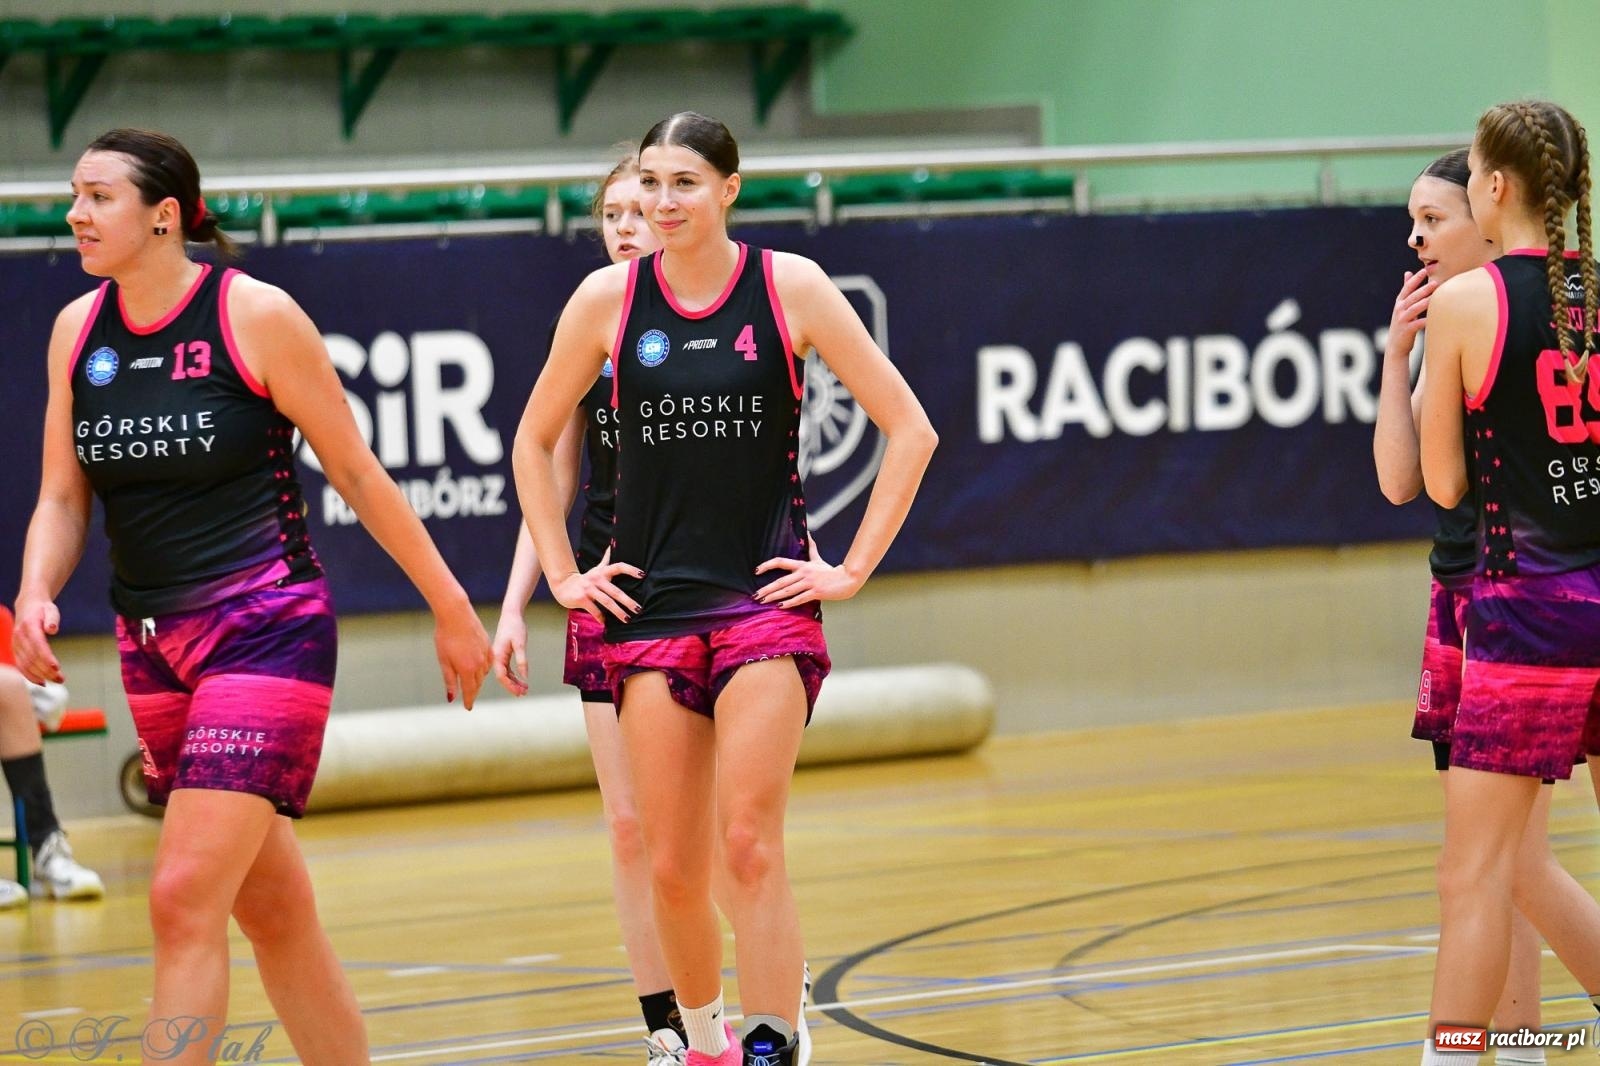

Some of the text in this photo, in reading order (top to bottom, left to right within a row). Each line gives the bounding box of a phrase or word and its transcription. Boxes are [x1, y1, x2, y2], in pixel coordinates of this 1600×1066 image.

[687, 338, 718, 351] PROTON
[734, 324, 758, 361] 4
[171, 340, 212, 380] 13
[976, 298, 1390, 444] RACIBÓR
[76, 434, 216, 465] RESORTY
[642, 420, 763, 446] RESORTY
